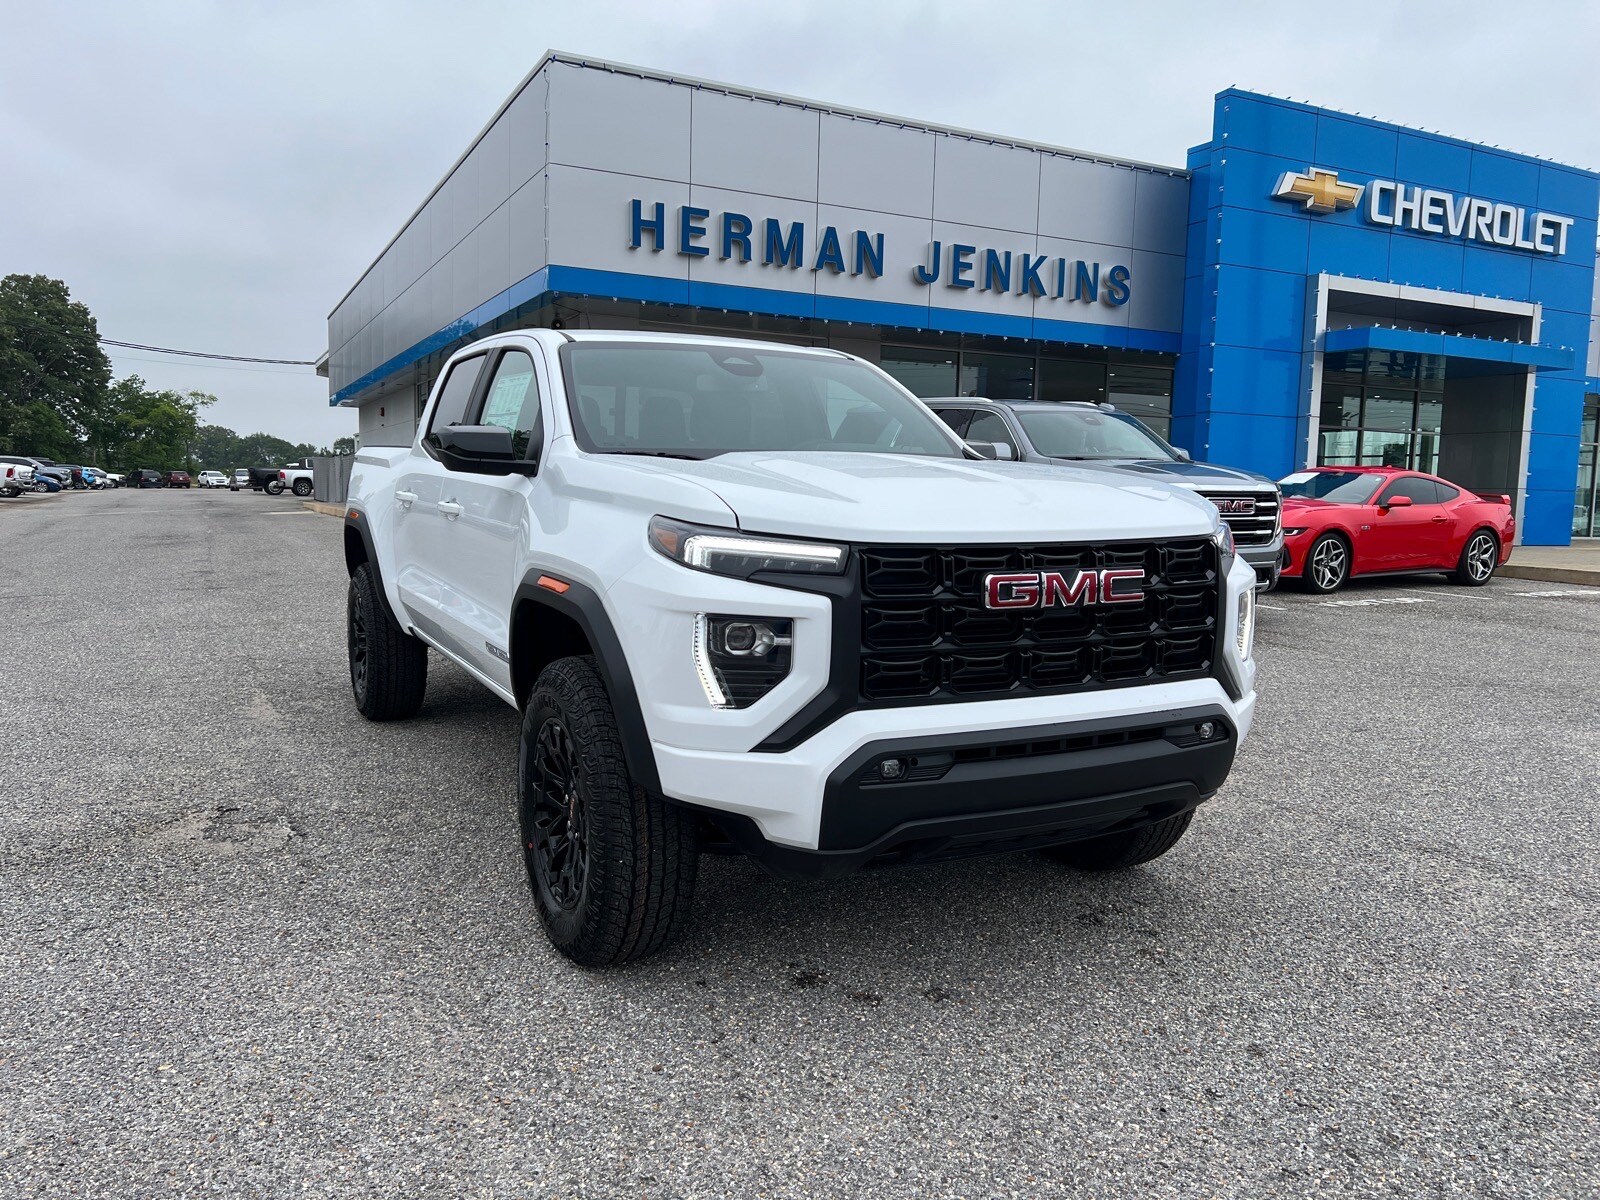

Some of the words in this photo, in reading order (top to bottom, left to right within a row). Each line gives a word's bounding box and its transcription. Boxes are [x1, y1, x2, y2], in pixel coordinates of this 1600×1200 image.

[629, 199, 884, 277] HERMAN
[912, 240, 1131, 306] JENKINS
[1366, 180, 1574, 255] CHEVROLET
[985, 569, 1145, 608] GMC
